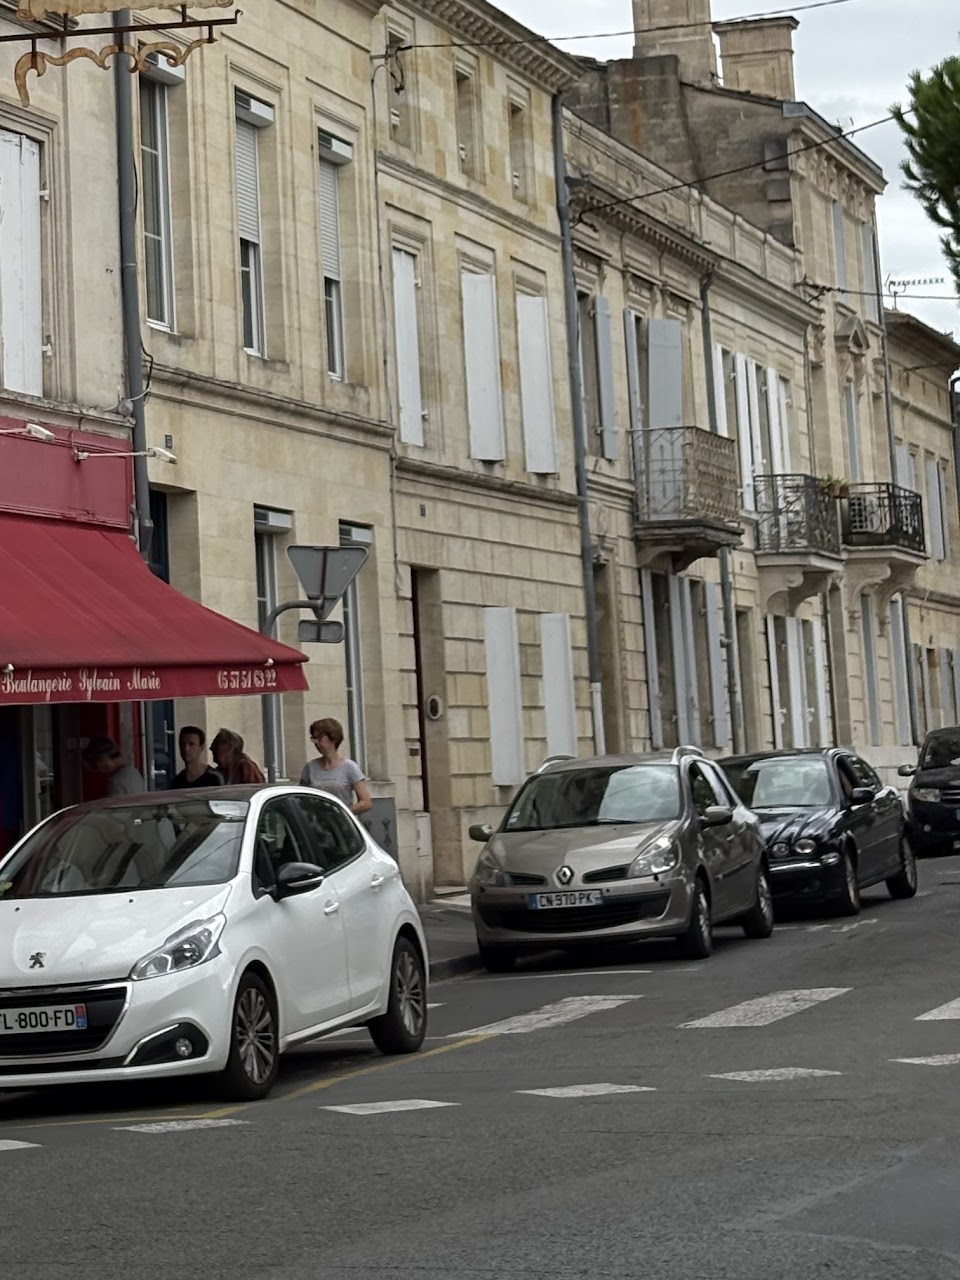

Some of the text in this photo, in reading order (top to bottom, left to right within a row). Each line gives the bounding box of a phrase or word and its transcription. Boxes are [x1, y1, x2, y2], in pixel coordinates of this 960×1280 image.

[1, 667, 161, 701] Boulangerie Sylvain Marie
